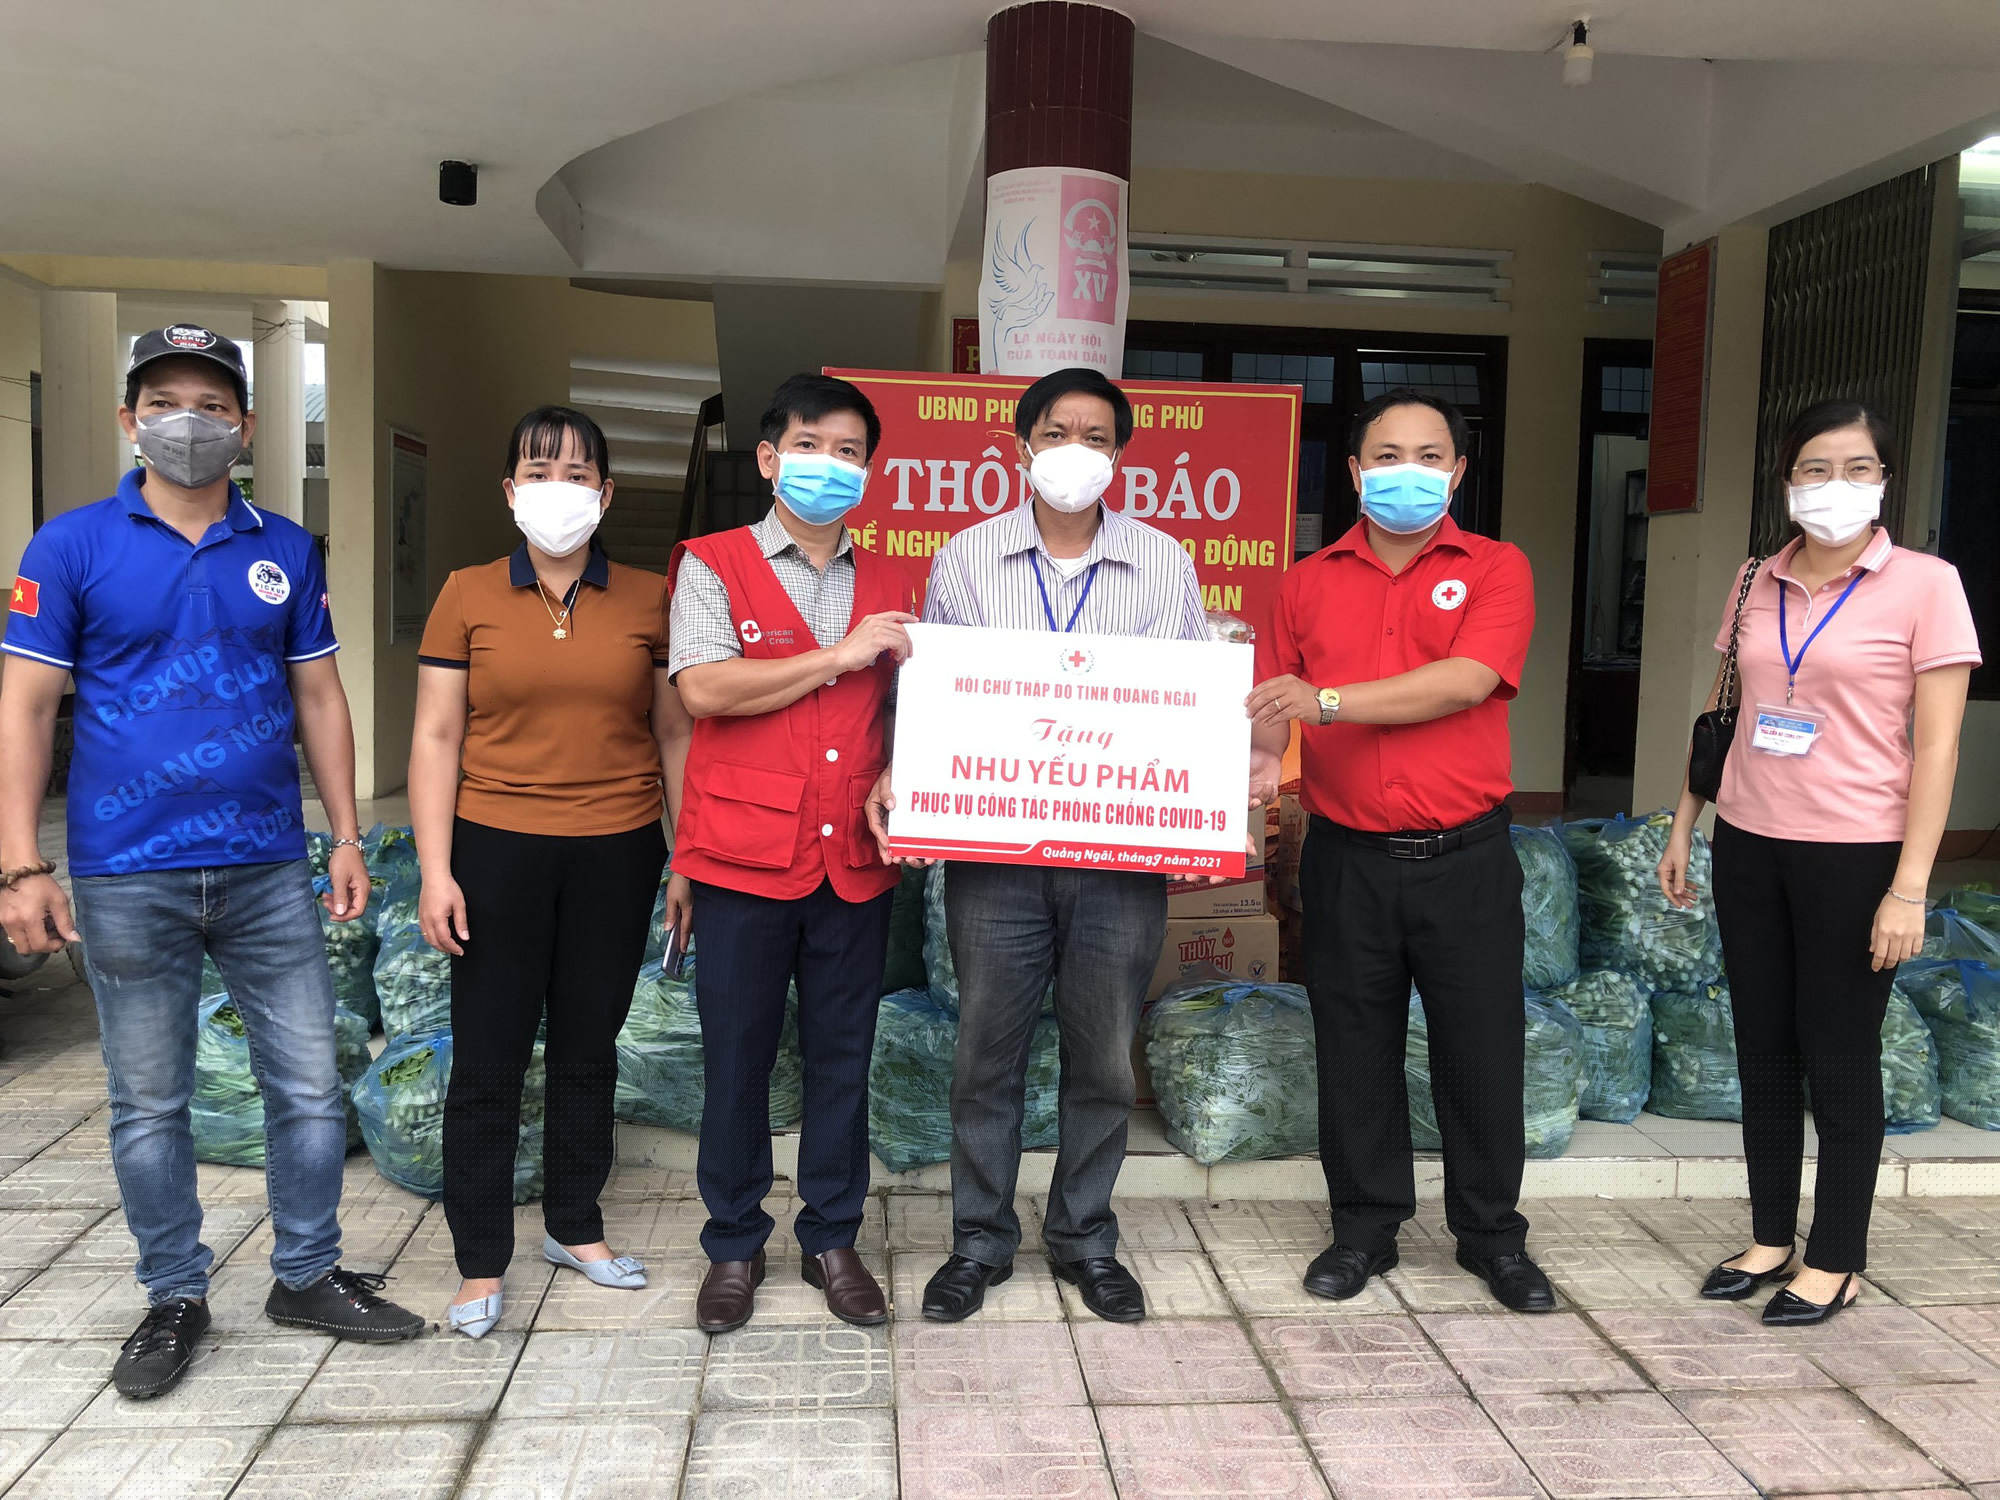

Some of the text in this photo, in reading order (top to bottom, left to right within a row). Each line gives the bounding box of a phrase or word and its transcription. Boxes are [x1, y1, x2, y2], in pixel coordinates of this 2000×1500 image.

[1073, 270, 1109, 303] XV
[1080, 333, 1102, 350] HỘI
[918, 395, 978, 421] UBND
[985, 398, 1020, 423] PH
[1160, 401, 1204, 430] PHÚ
[1120, 451, 1241, 521] BÁO
[1204, 534, 1275, 572] ĐỘNG
[255, 582, 286, 595] PICKUP
[768, 637, 794, 645] Cross
[96, 645, 220, 729] PICKUP
[214, 653, 277, 700] CLUB
[955, 675, 979, 695] HỘI
[983, 677, 1013, 695] CHỮ
[1015, 680, 1050, 699] THẬP
[1030, 718, 1114, 750] Tặng
[94, 741, 227, 821] QUANG
[951, 753, 1189, 794] NHU YẾU PHẨM
[911, 790, 1227, 832] PHỤC VỤ CÔNG TÁC PHÒNG CHỐNG COVID-19
[105, 800, 241, 874] PICKUP
[224, 806, 293, 860] CLUB
[1042, 846, 1082, 862] Quảng
[1084, 848, 1116, 863] Ngãi,
[1163, 854, 1190, 866] năm
[1191, 856, 1222, 868] 2021
[1178, 935, 1216, 962] THỦY
